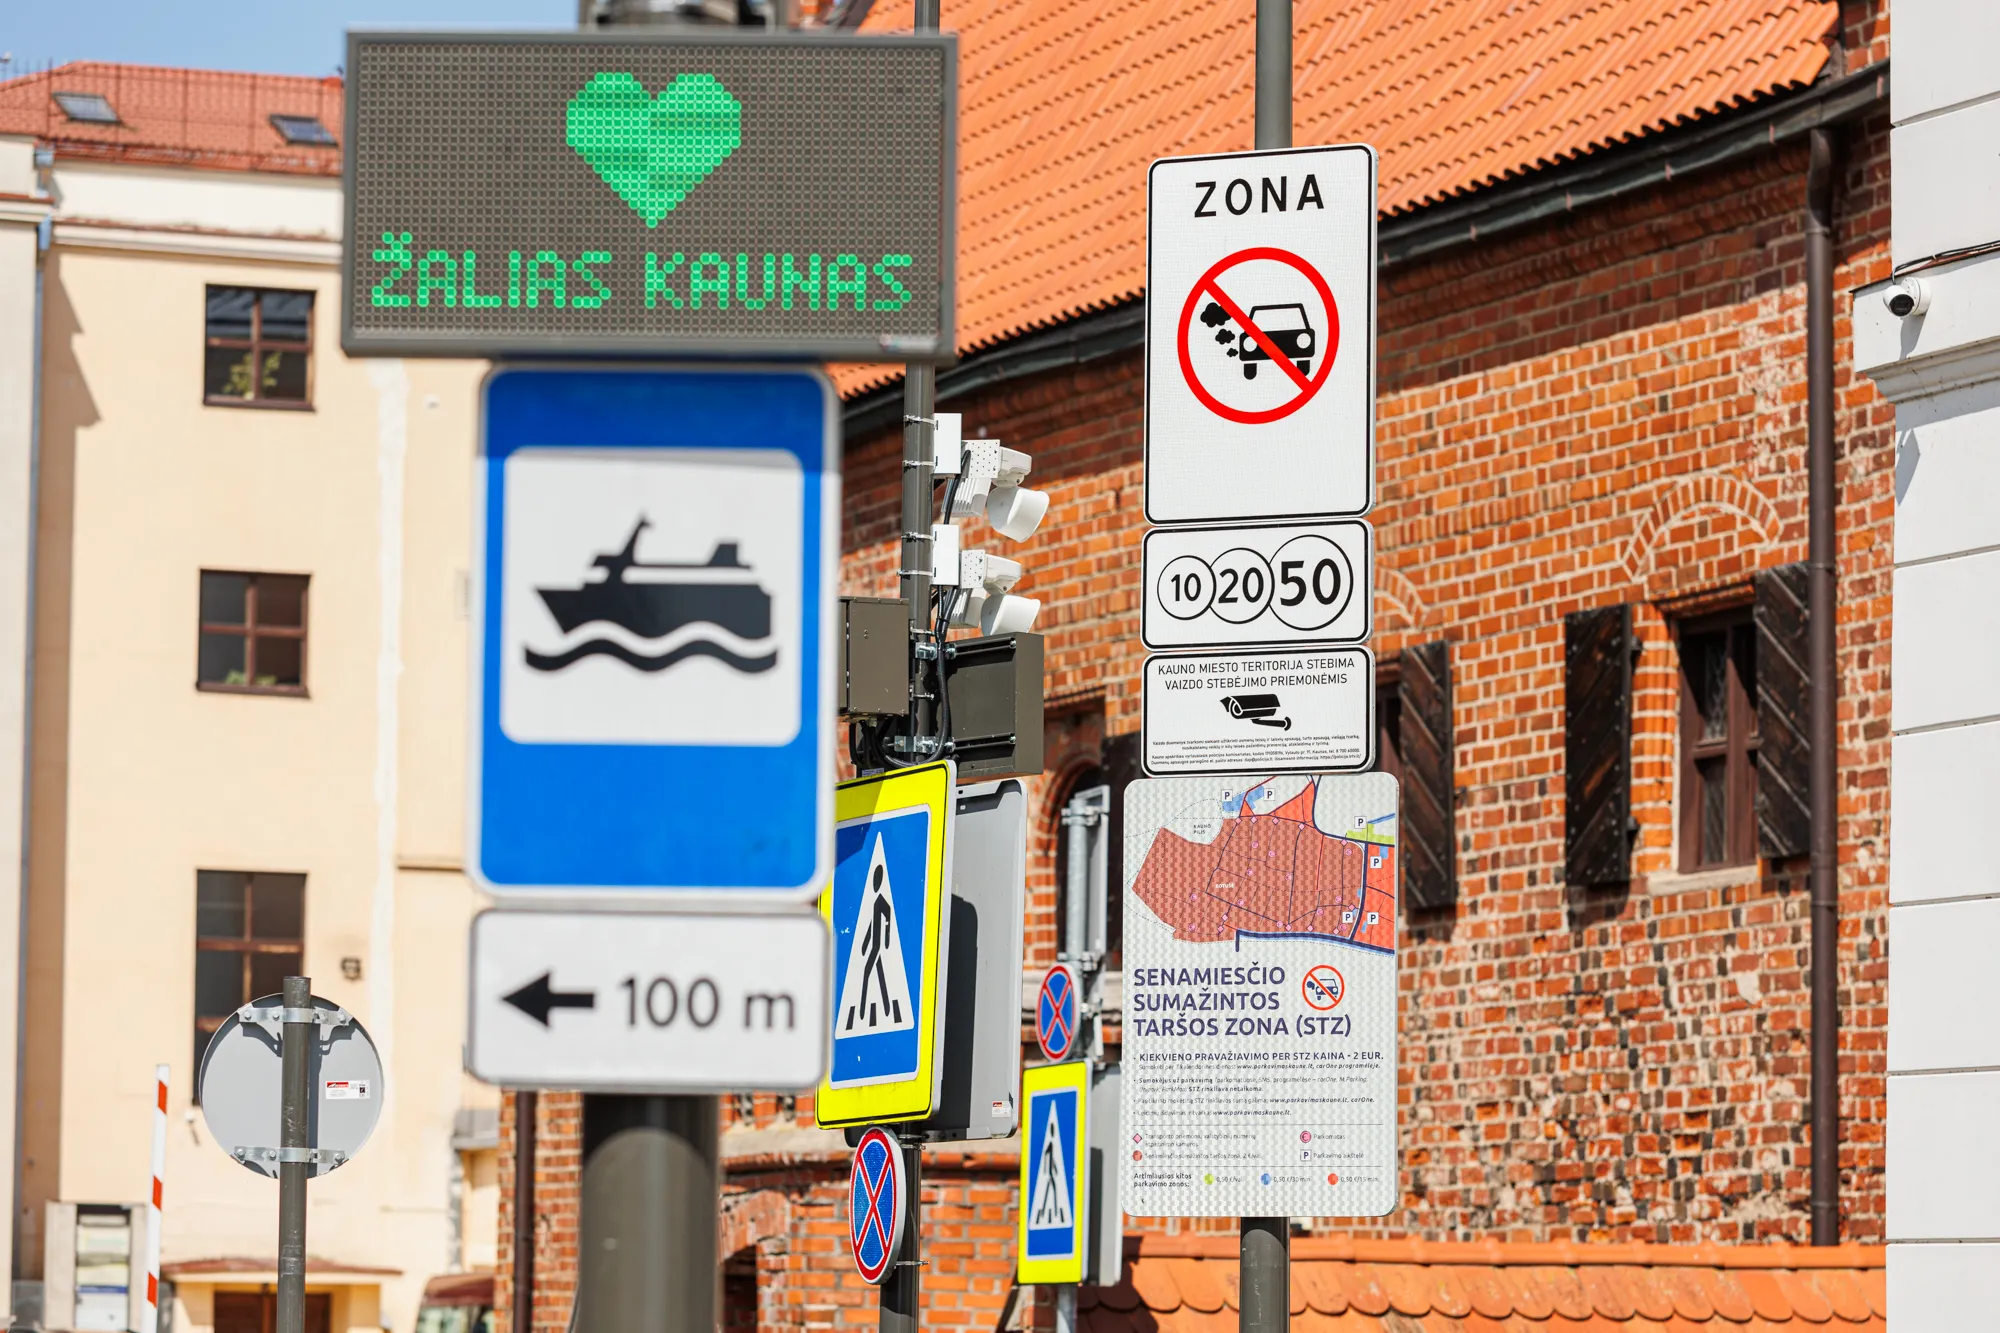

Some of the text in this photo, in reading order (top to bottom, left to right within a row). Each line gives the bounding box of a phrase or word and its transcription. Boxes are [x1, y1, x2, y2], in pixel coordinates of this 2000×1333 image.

[1194, 174, 1324, 218] ZONA
[372, 231, 912, 312] ŽALIAS KAUNAS
[1171, 558, 1341, 607] 10 20 50
[1158, 658, 1355, 675] KAUNO MIESTO TERITORIJA STEBIMA
[1165, 672, 1348, 690] VAIZDO STEBĖJIMO PRIEMONĖMIS
[1373, 858, 1380, 866] P
[1370, 914, 1376, 922] P
[1133, 961, 1286, 987] SENAMIESČIO
[620, 976, 795, 1029] 100 m
[1133, 987, 1280, 1011] SUMAŽINTOS
[1133, 1012, 1351, 1038] TARŠOS ZONA (STZ)
[1139, 1053, 1192, 1062] KIEKVIENO
[1194, 1051, 1269, 1061] PRAVAŽIAVIMO
[1272, 1052, 1291, 1060] PER
[1293, 1052, 1310, 1060] STZ
[1313, 1052, 1345, 1060] KAINA
[1353, 1052, 1359, 1060] 2
[1361, 1052, 1384, 1060] EUR.
